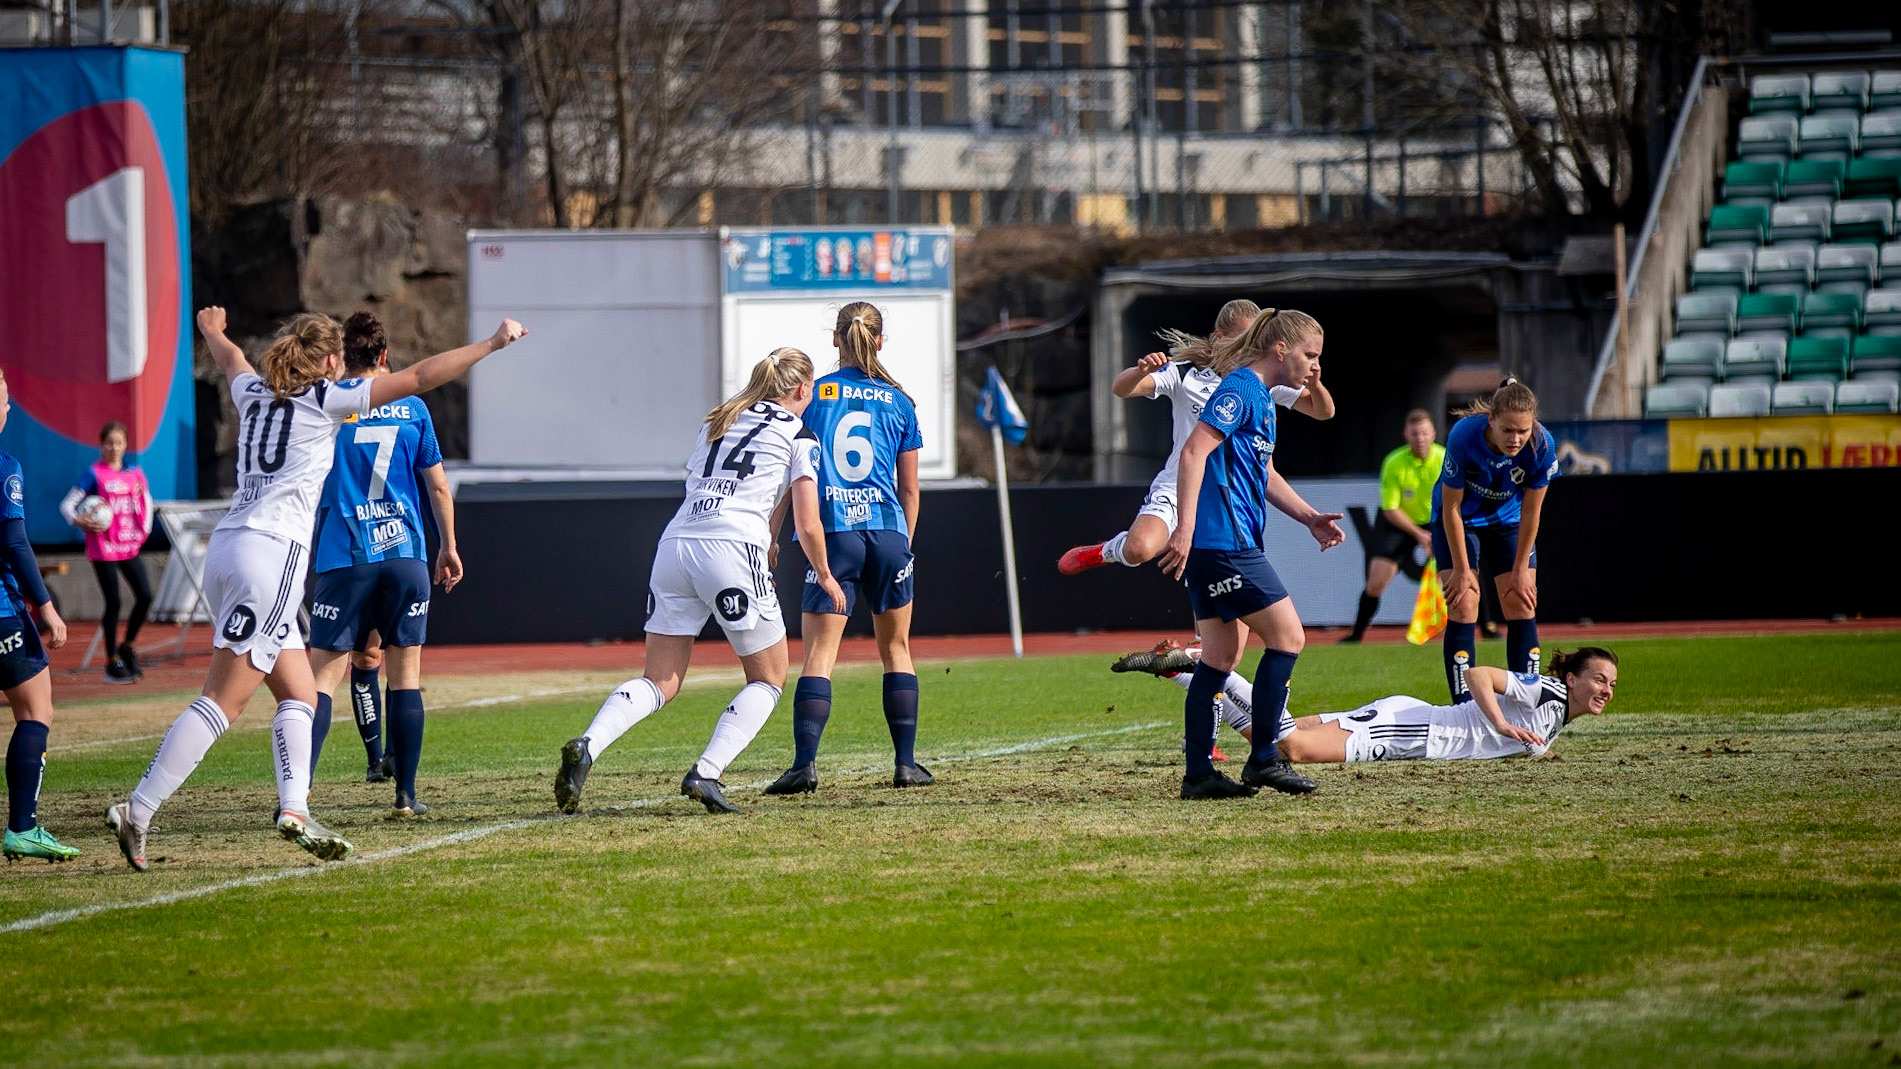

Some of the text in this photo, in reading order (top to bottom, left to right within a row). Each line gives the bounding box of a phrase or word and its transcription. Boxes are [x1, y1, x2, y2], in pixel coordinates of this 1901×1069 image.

[65, 166, 148, 384] 1
[843, 386, 893, 404] BACKE
[1215, 405, 1235, 421] OBOS
[244, 399, 295, 474] 10
[833, 410, 874, 483] 6
[353, 425, 400, 501] 7
[702, 422, 770, 481] 14
[691, 497, 724, 515] MOT
[825, 486, 884, 503] PETTERSEN
[847, 503, 871, 518] MOT
[372, 519, 404, 544] MOT
[805, 569, 819, 584] SAT
[1208, 574, 1243, 598] SATS
[311, 601, 341, 621] SATS
[274, 726, 294, 782] RAMIRENT
